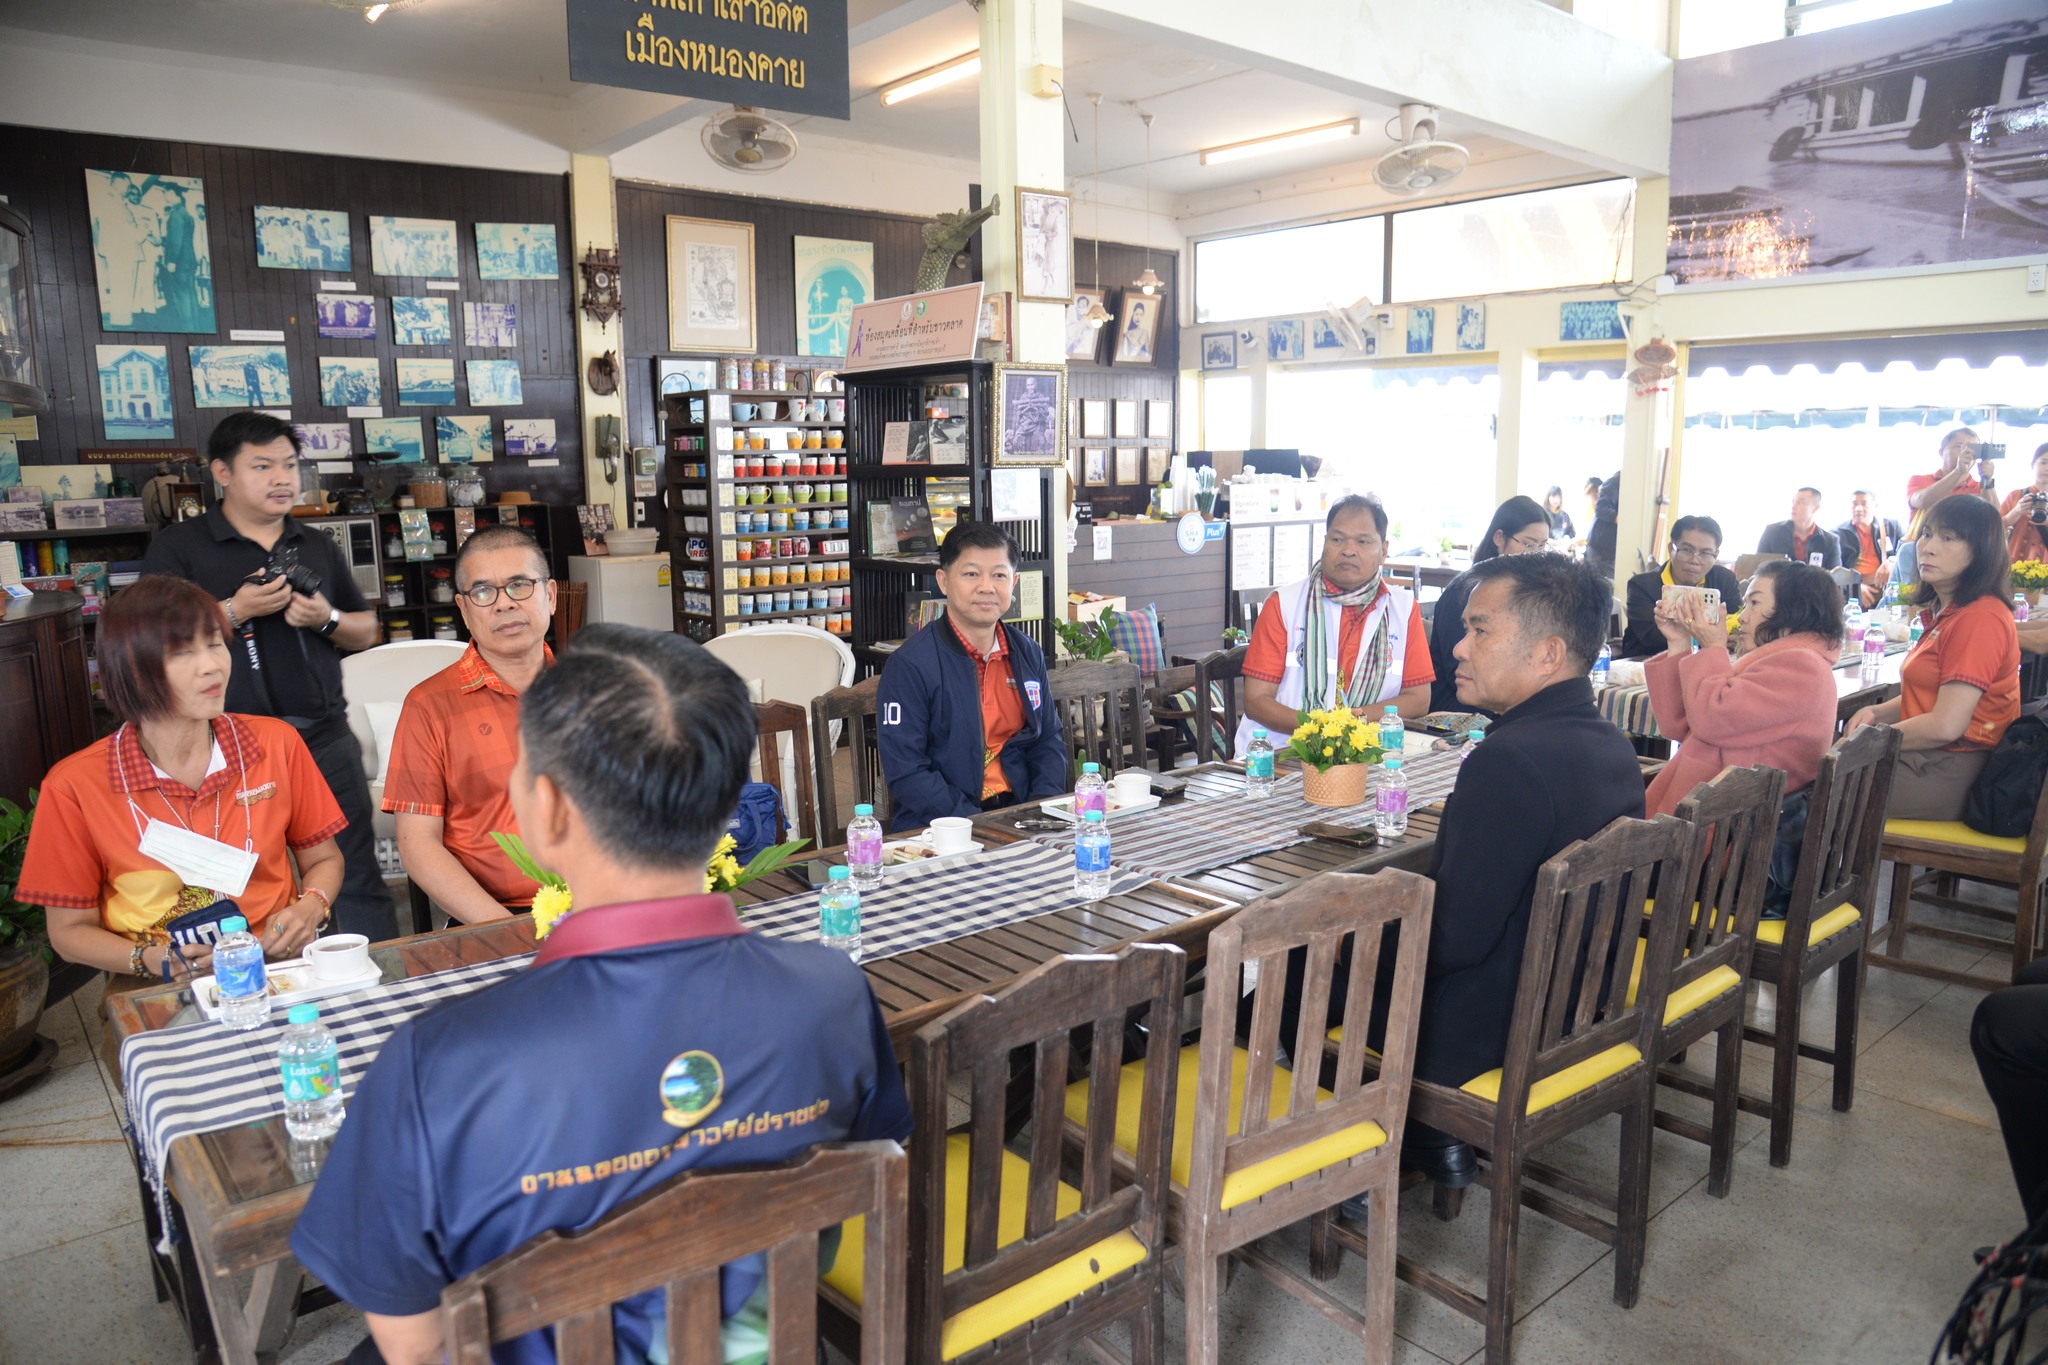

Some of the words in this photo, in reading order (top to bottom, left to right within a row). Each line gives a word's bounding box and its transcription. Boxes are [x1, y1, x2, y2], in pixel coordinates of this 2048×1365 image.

[624, 13, 805, 89] เมืองหนองคาย
[246, 640, 260, 670] SONY
[883, 702, 901, 725] 10
